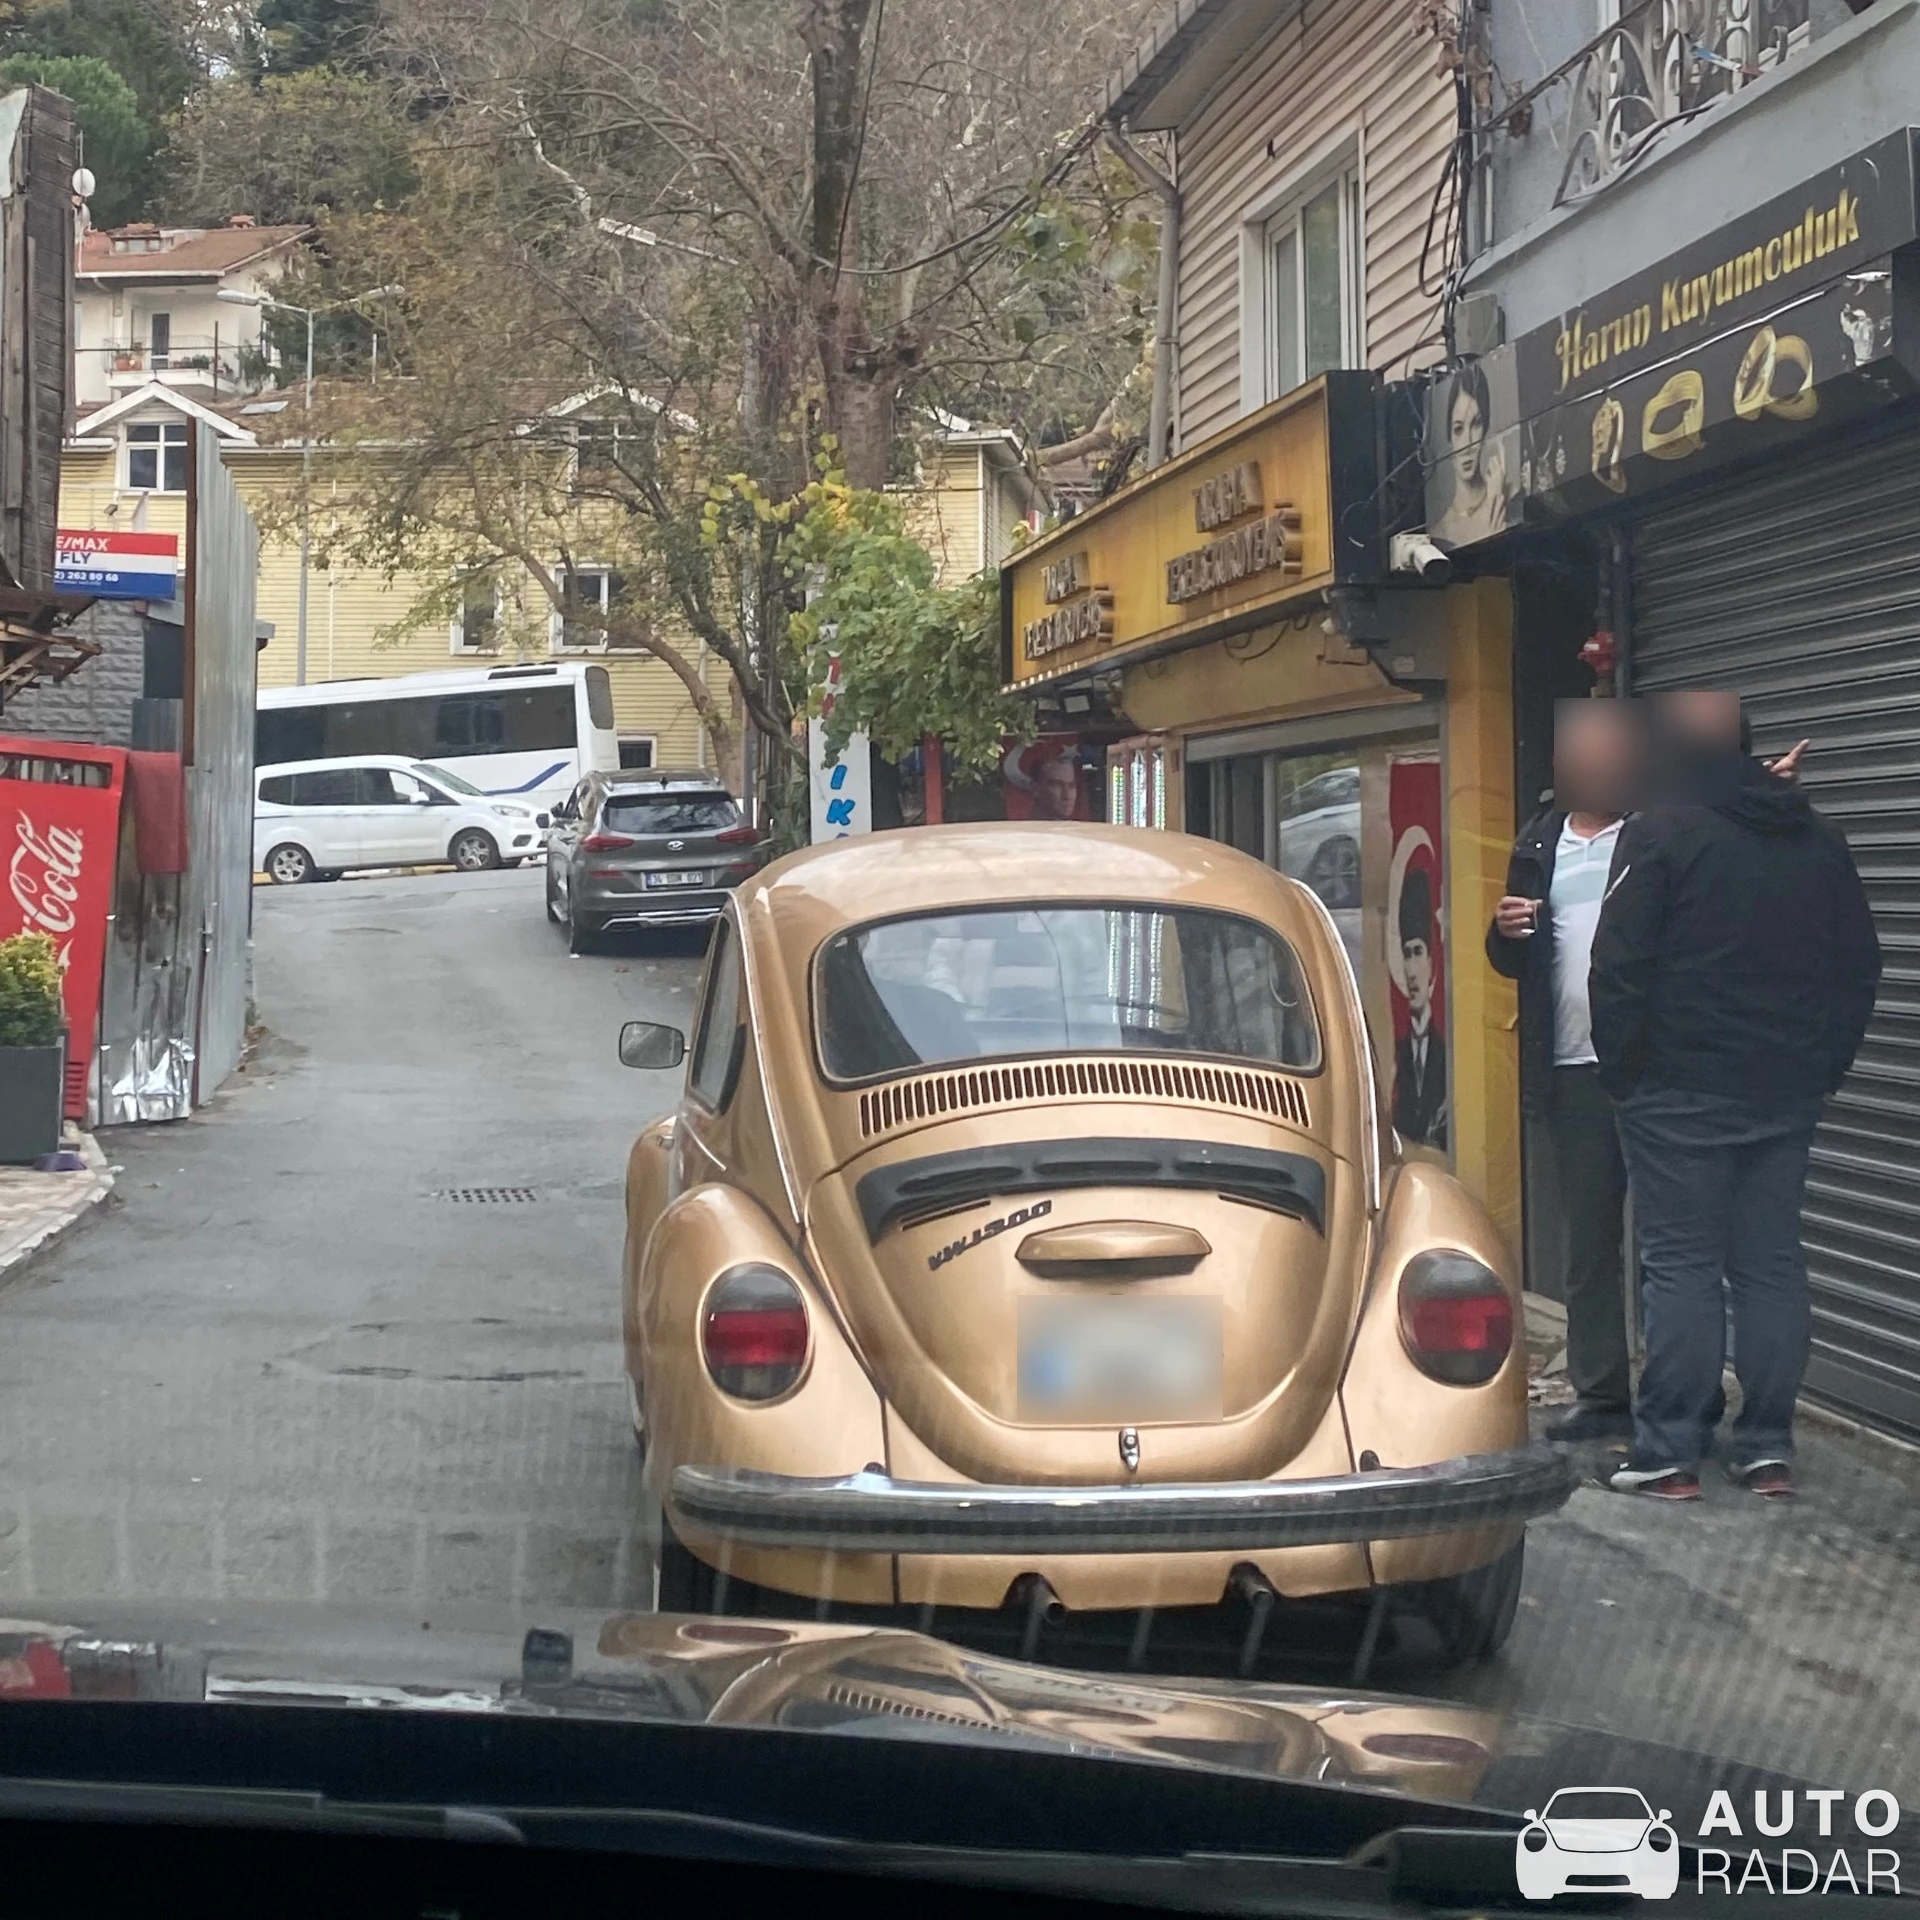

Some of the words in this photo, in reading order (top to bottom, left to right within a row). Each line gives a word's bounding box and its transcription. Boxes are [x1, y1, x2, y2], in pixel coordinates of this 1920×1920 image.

[1553, 310, 1651, 395] Harun
[1661, 188, 1860, 333] Kuyumculuk
[56, 535, 110, 551] E/MAX
[60, 552, 91, 564] FLY
